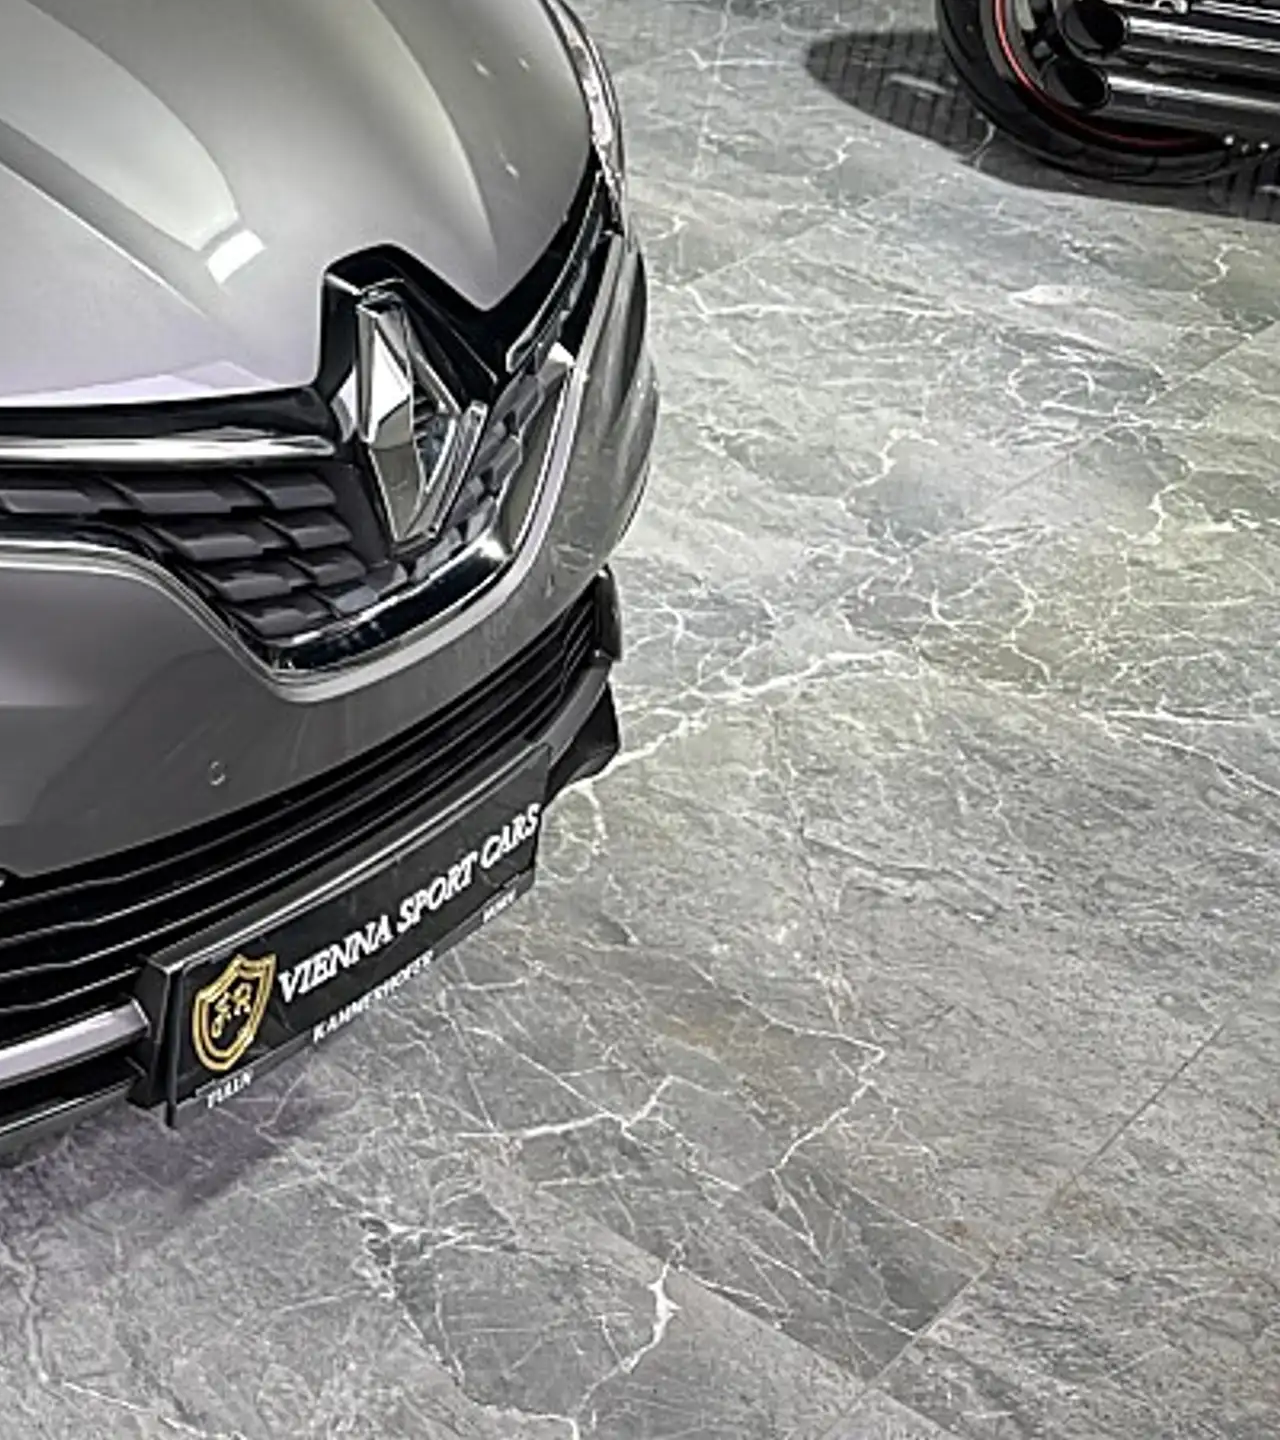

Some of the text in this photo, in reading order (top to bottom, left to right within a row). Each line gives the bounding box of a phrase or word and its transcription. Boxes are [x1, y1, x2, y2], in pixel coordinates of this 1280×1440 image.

[278, 913, 393, 1003] VIENNA
[396, 855, 478, 934] SPORT
[479, 803, 541, 869] CARS
